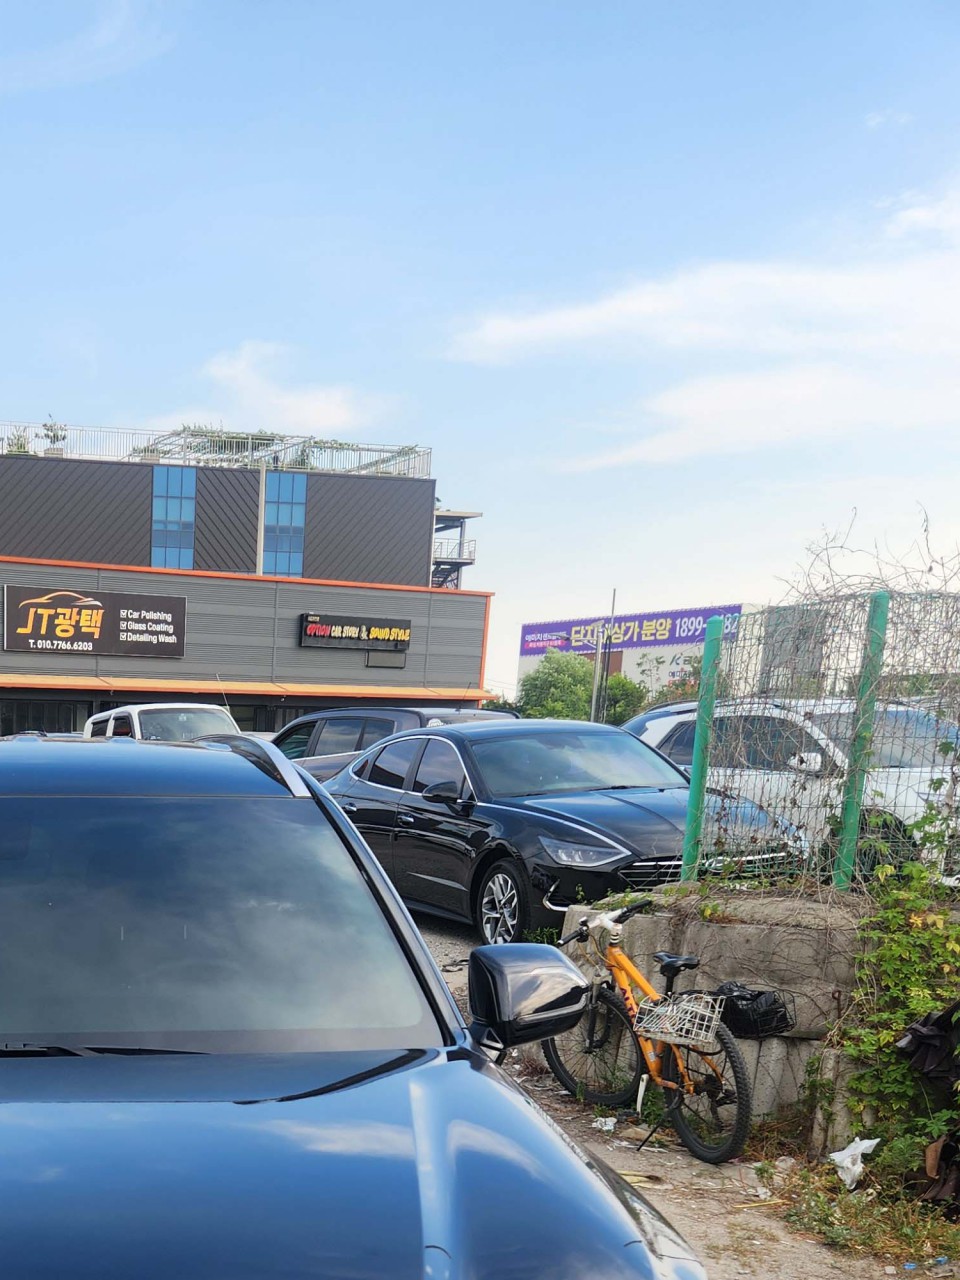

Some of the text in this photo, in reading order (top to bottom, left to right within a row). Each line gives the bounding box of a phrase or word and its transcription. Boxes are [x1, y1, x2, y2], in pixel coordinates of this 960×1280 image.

[127, 609, 172, 621] Car Polishing
[16, 607, 105, 639] JT광택
[127, 621, 173, 633] Glass Coating
[641, 618, 672, 641] 분양
[675, 612, 739, 638] 1899-82
[307, 624, 331, 636] OPTION
[331, 625, 342, 637] CAR
[342, 625, 359, 638] STORY
[360, 625, 368, 640] &
[390, 627, 410, 640] STYLE
[127, 633, 177, 644] Detailing Wash
[37, 640, 93, 651] 010.7766.6203
